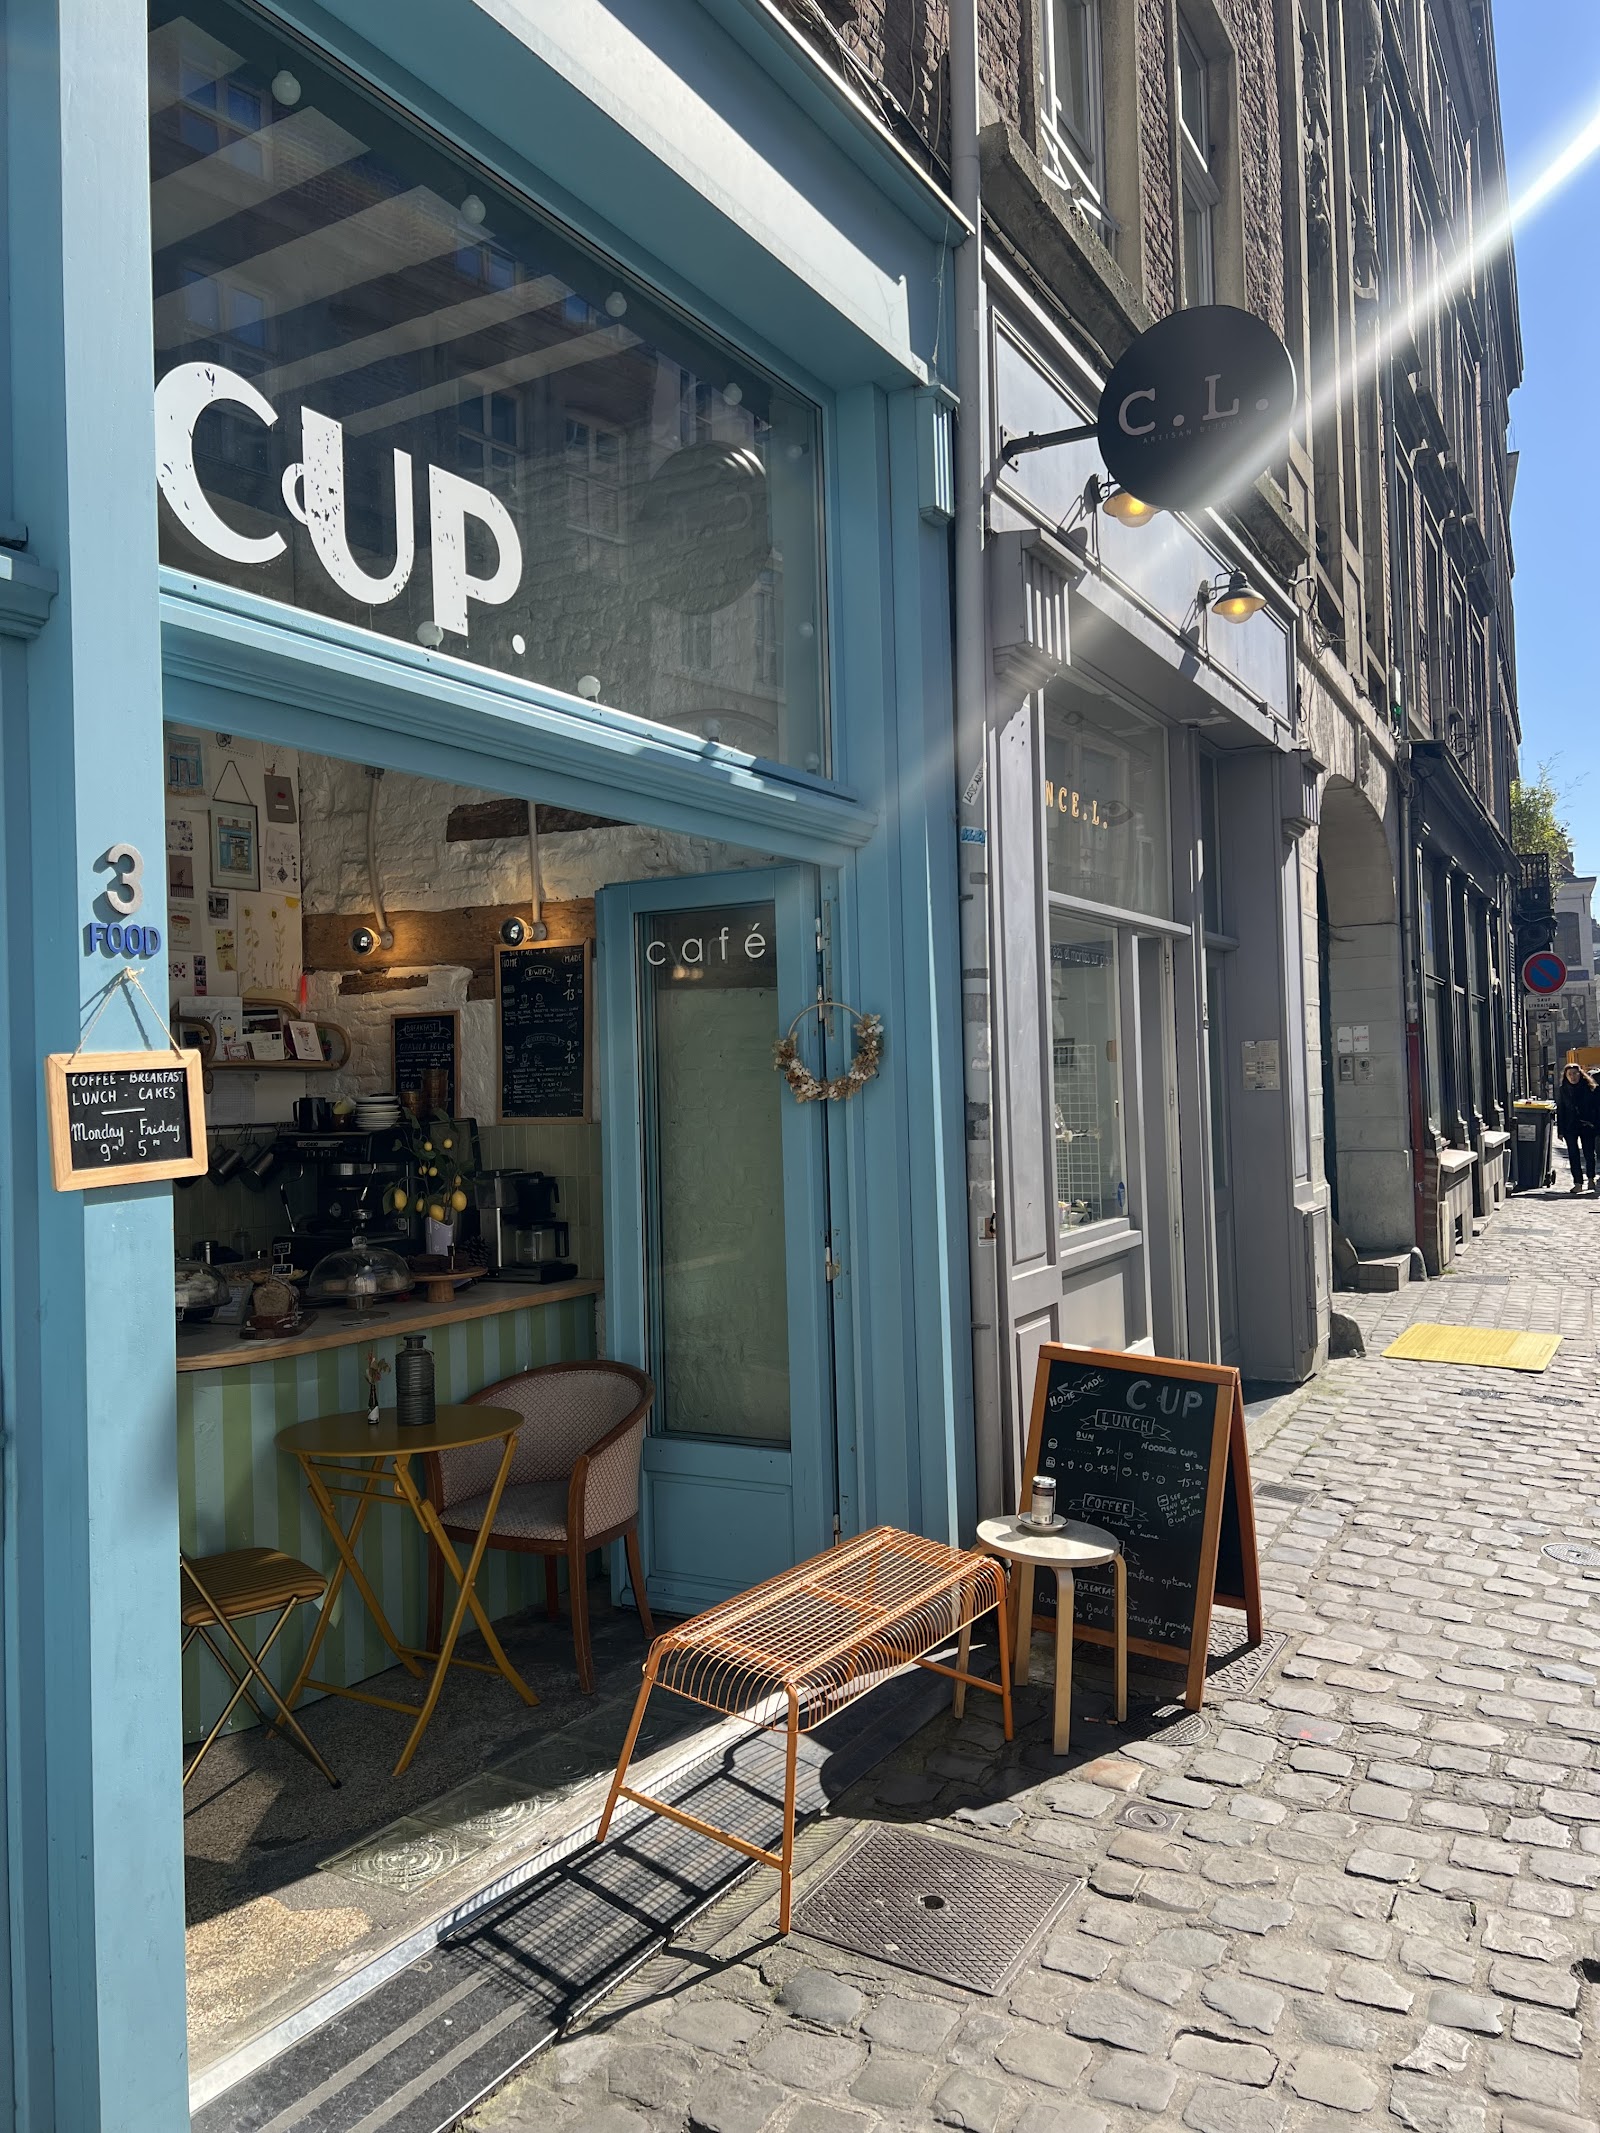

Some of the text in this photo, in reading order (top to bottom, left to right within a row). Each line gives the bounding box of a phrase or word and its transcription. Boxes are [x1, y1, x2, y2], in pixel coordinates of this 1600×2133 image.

[1142, 429, 1192, 444] ARTISAN
[106, 843, 144, 915] 3
[90, 922, 161, 956] FOOD
[645, 922, 766, 966] café
[564, 953, 582, 964] MADE
[406, 1022, 436, 1033] BREAKFAST
[72, 1072, 117, 1087] COFFEE
[129, 1071, 184, 1084] BREAKFAST
[72, 1089, 117, 1106] LUNCH
[138, 1087, 176, 1100] CAKES
[71, 1122, 125, 1148] Monday
[139, 1118, 180, 1143] Friday
[1048, 1374, 1105, 1407] HOME MADE
[1126, 1380, 1203, 1418] CUP
[1101, 1412, 1150, 1433] LUNCH
[1075, 1430, 1095, 1440] BUN
[1140, 1441, 1198, 1459] NOODLES CUPS
[1086, 1495, 1130, 1514] COFFEE
[1169, 1492, 1181, 1501] SEE
[1081, 1511, 1091, 1524] by
